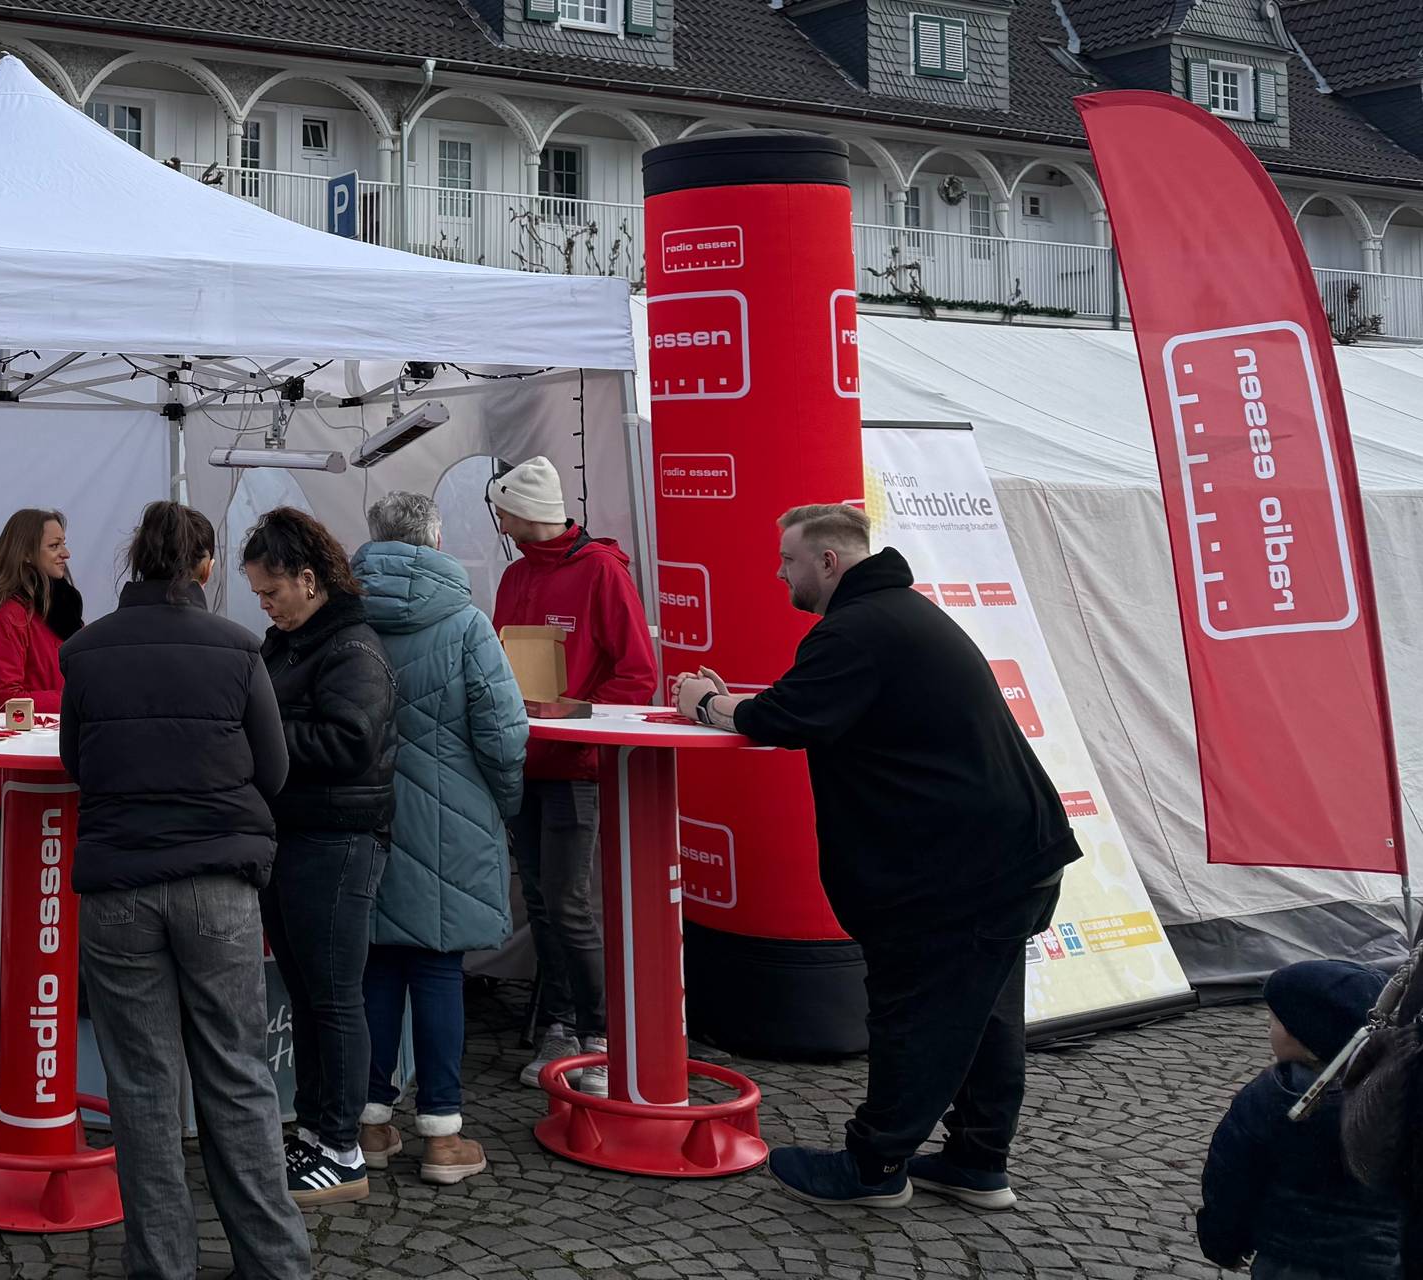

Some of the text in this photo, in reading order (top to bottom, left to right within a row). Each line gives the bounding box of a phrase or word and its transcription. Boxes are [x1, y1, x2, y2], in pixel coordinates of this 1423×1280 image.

[333, 184, 348, 233] P
[666, 239, 737, 253] radio essen
[654, 330, 731, 349] essen
[663, 467, 728, 477] radio essen
[882, 472, 919, 488] Aktion
[887, 491, 993, 517] Lichtblicke
[29, 807, 62, 1104] radio essen
